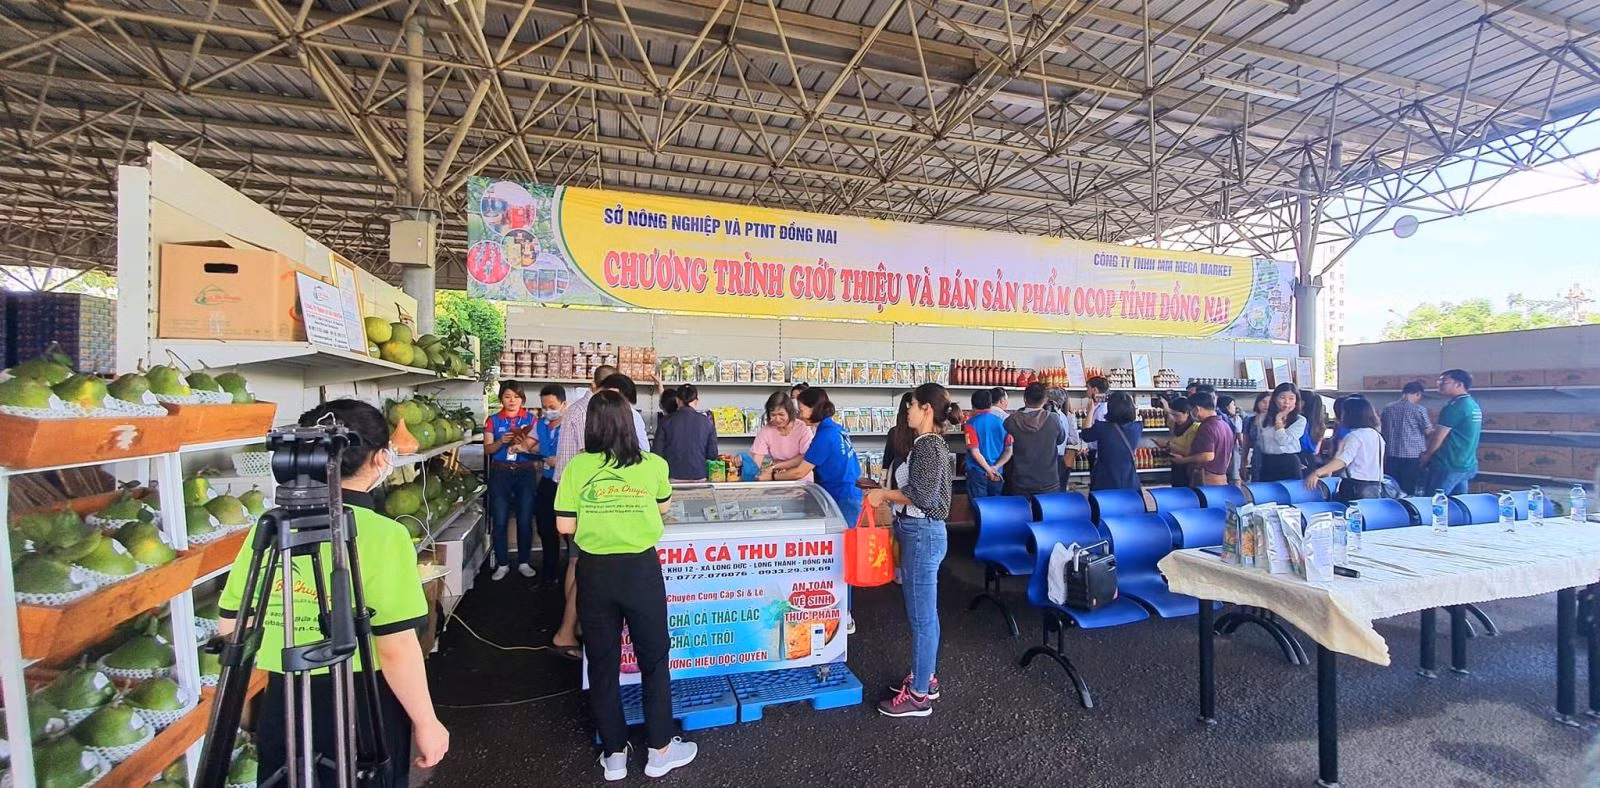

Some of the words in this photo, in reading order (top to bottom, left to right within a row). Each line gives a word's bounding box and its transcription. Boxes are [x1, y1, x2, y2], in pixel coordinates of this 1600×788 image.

[604, 205, 623, 225] SỞ
[627, 209, 667, 229] NÔNG
[671, 214, 721, 237] NGHIỆP
[725, 218, 741, 236] VÀ
[745, 222, 776, 239] PTNT
[779, 221, 813, 243] ĐỒNG
[816, 228, 838, 244] NAI
[1093, 251, 1118, 268] CÔNG
[1121, 256, 1131, 268] TY
[1133, 257, 1155, 270] TNHH
[1157, 259, 1173, 272] MM
[1175, 261, 1198, 274] MEGA
[1200, 263, 1232, 277] MARKET
[604, 248, 709, 292] CHƯƠNG
[713, 252, 785, 297] TRÌNH
[789, 257, 837, 302] GIỚI
[840, 262, 902, 313] THIỆU
[906, 266, 934, 306] VÀ
[938, 268, 978, 309] BÁN
[981, 268, 1019, 312] SẢN
[1022, 267, 1070, 315] PHẨM
[1073, 287, 1115, 317] OCOP
[1119, 280, 1158, 320] TỈNH
[1159, 280, 1200, 322] ĐỒNG
[657, 543, 698, 565] CHẢ
[705, 542, 732, 562] CÁ
[738, 543, 778, 560] THU
[785, 538, 833, 558] BÌNH
[792, 582, 806, 591] AN
[698, 592, 718, 601] Cung
[808, 595, 831, 605] SINH
[669, 609, 690, 627] CHẢ
[694, 608, 708, 625] CÁ
[712, 608, 738, 624] THÁC
[669, 631, 690, 648] CHẢ
[694, 631, 708, 646] CÁ
[711, 630, 733, 645] TRÔI
